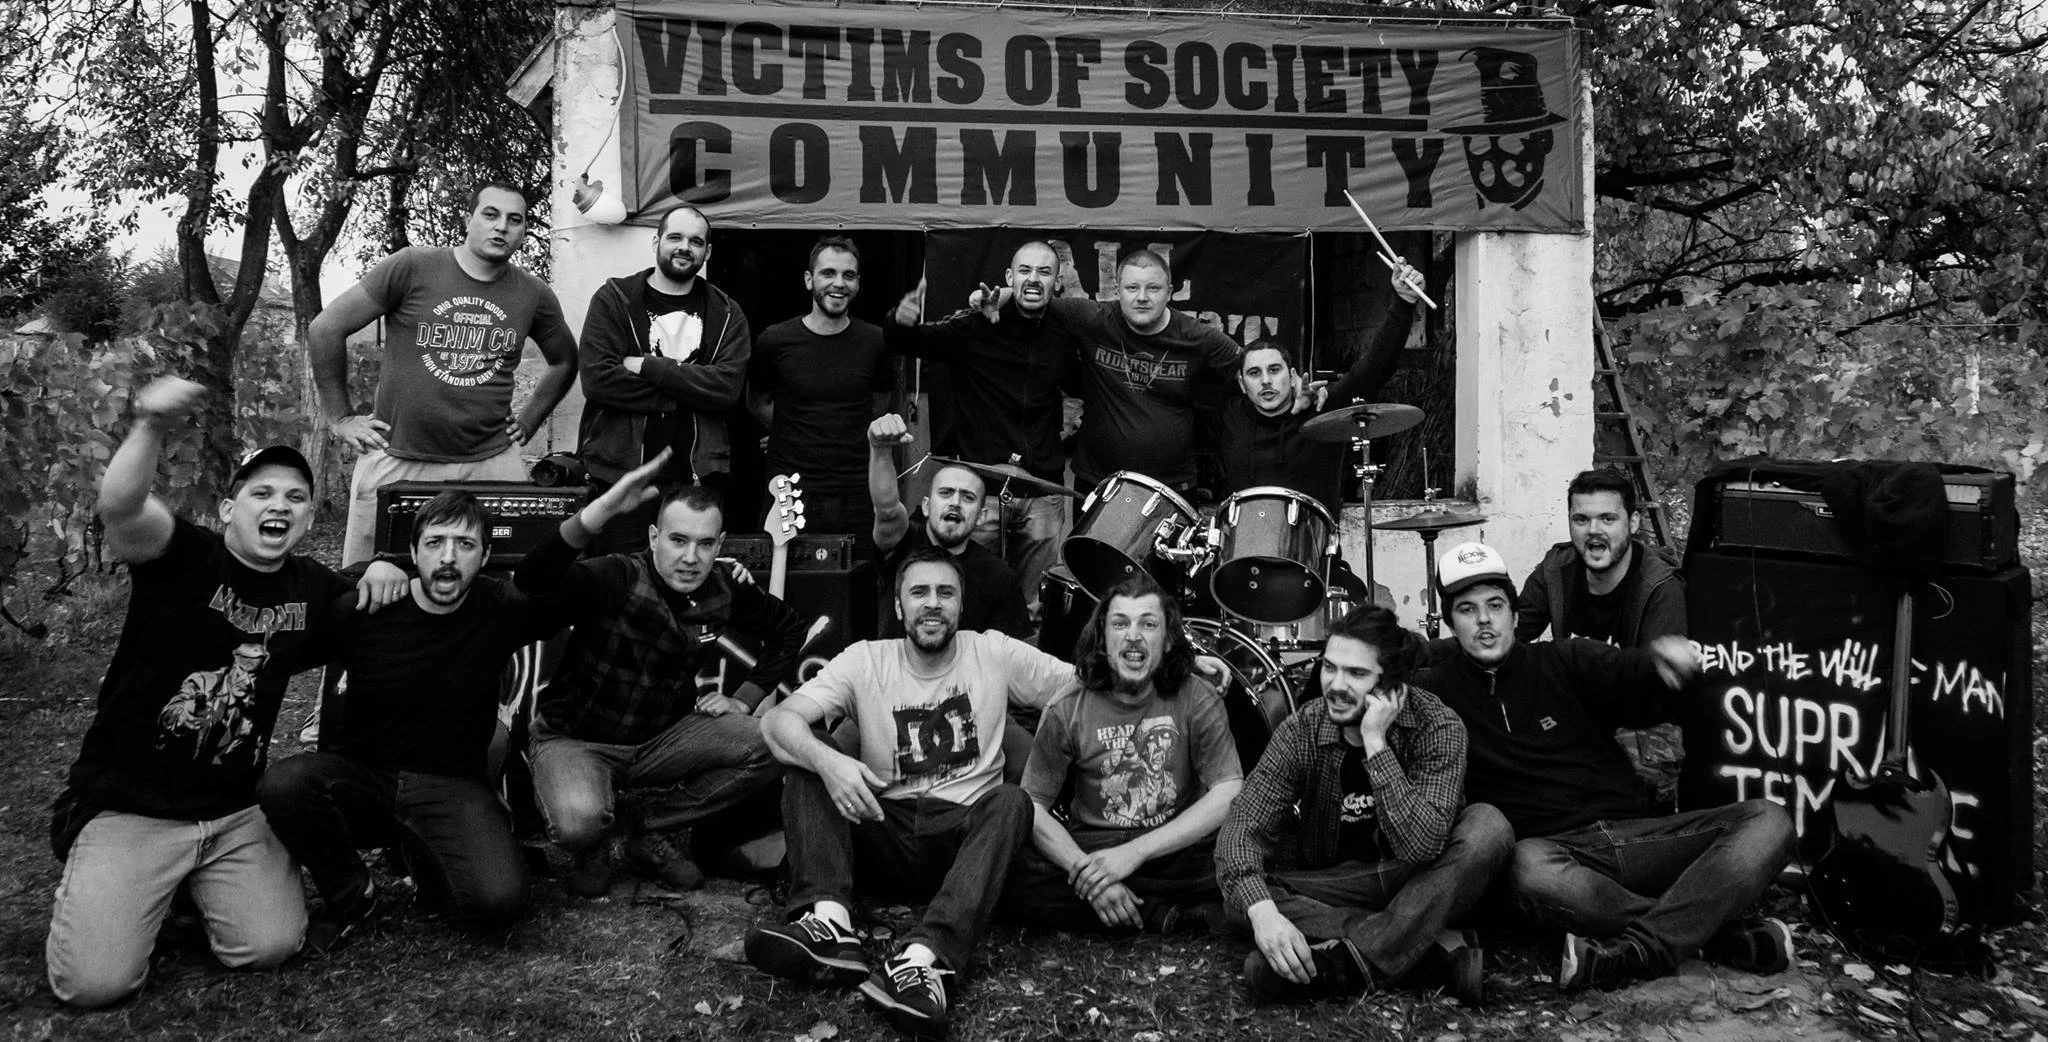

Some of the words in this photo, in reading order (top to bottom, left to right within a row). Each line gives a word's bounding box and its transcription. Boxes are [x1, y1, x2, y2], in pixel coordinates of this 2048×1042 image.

[636, 20, 985, 105] VICTIMS
[1005, 34, 1101, 108] OF
[1124, 40, 1438, 115] SOCIETY
[669, 121, 1444, 208] COMMUNITY
[453, 296, 484, 306] QUALITY
[484, 301, 507, 321] GOODS
[453, 312, 493, 325] OFFICIAL
[416, 322, 486, 350] DENIM
[421, 353, 438, 372] HIGH
[433, 368, 476, 387] STANDARD
[1932, 660, 2006, 719] MAN
[1097, 724, 1135, 741] HEAR
